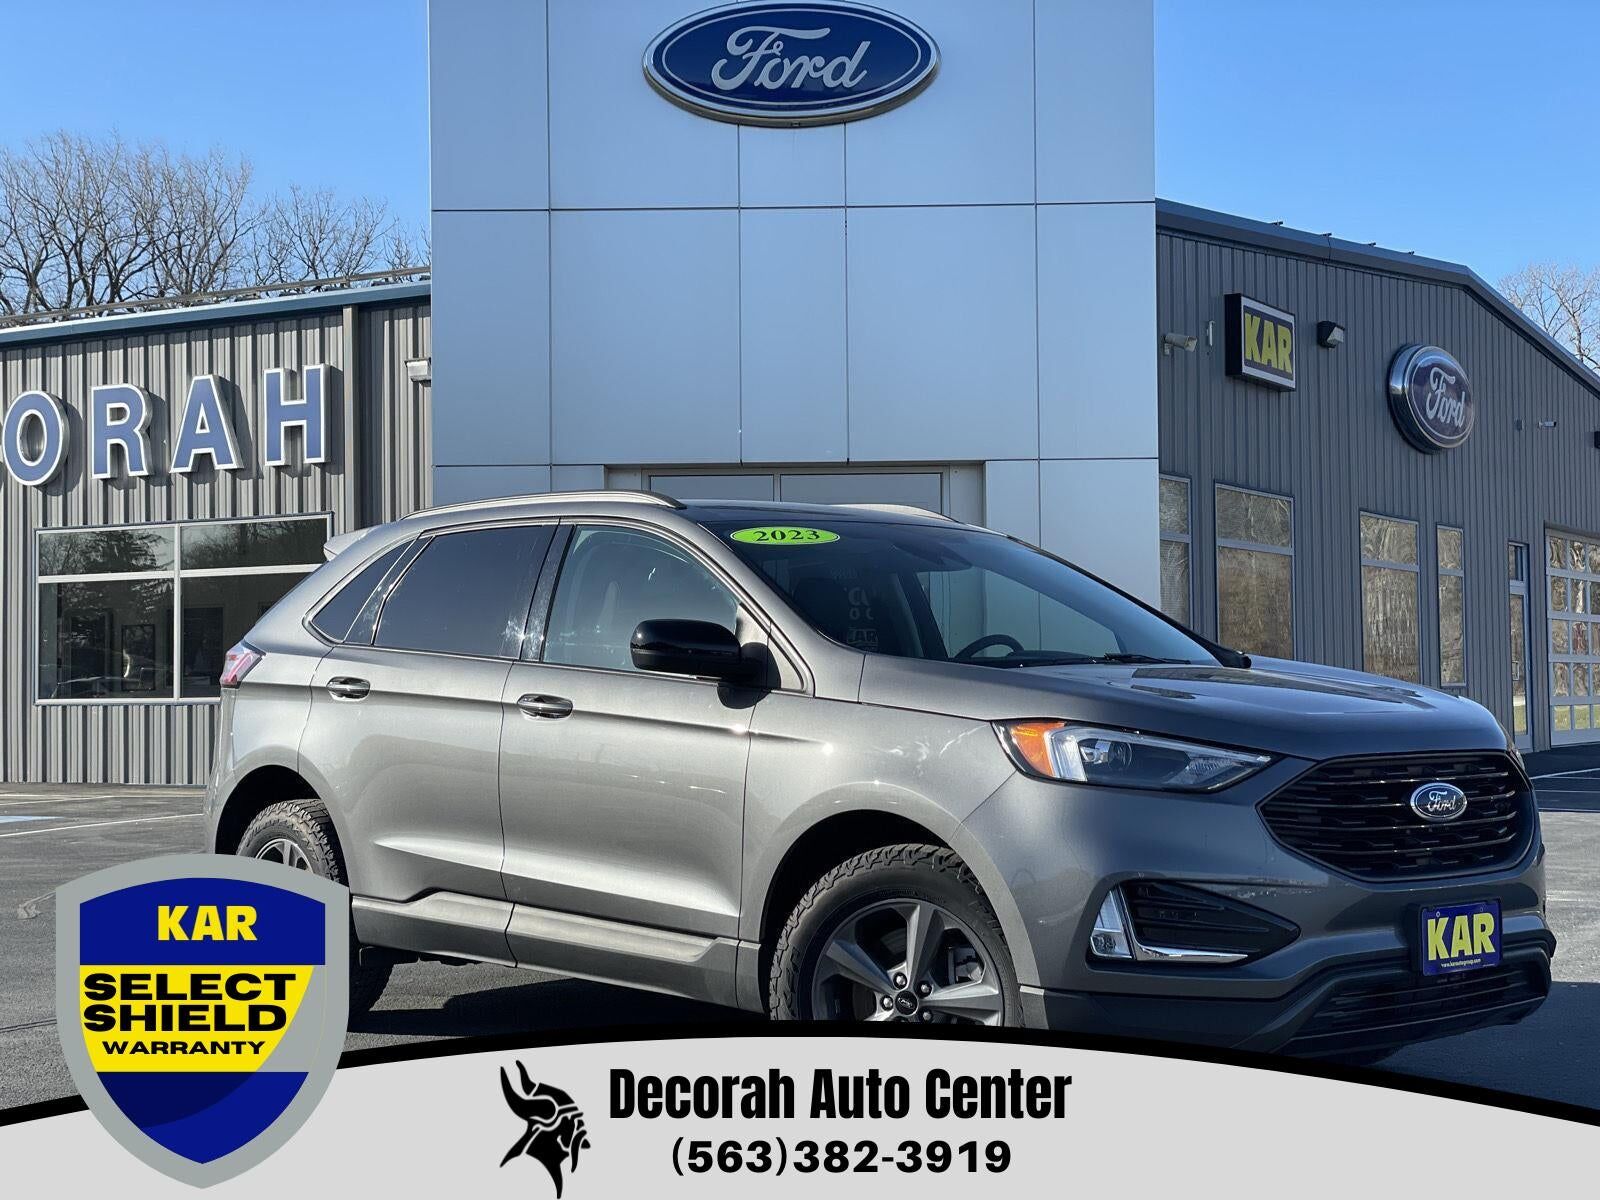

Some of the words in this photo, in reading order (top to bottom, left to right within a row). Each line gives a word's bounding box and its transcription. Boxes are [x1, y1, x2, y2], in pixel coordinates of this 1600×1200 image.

[711, 26, 871, 91] Ford
[1243, 312, 1293, 374] KAR
[1425, 366, 1467, 429] Ford
[755, 528, 821, 542] 2023
[1427, 790, 1457, 813] Ford
[1427, 912, 1496, 961] KAR
